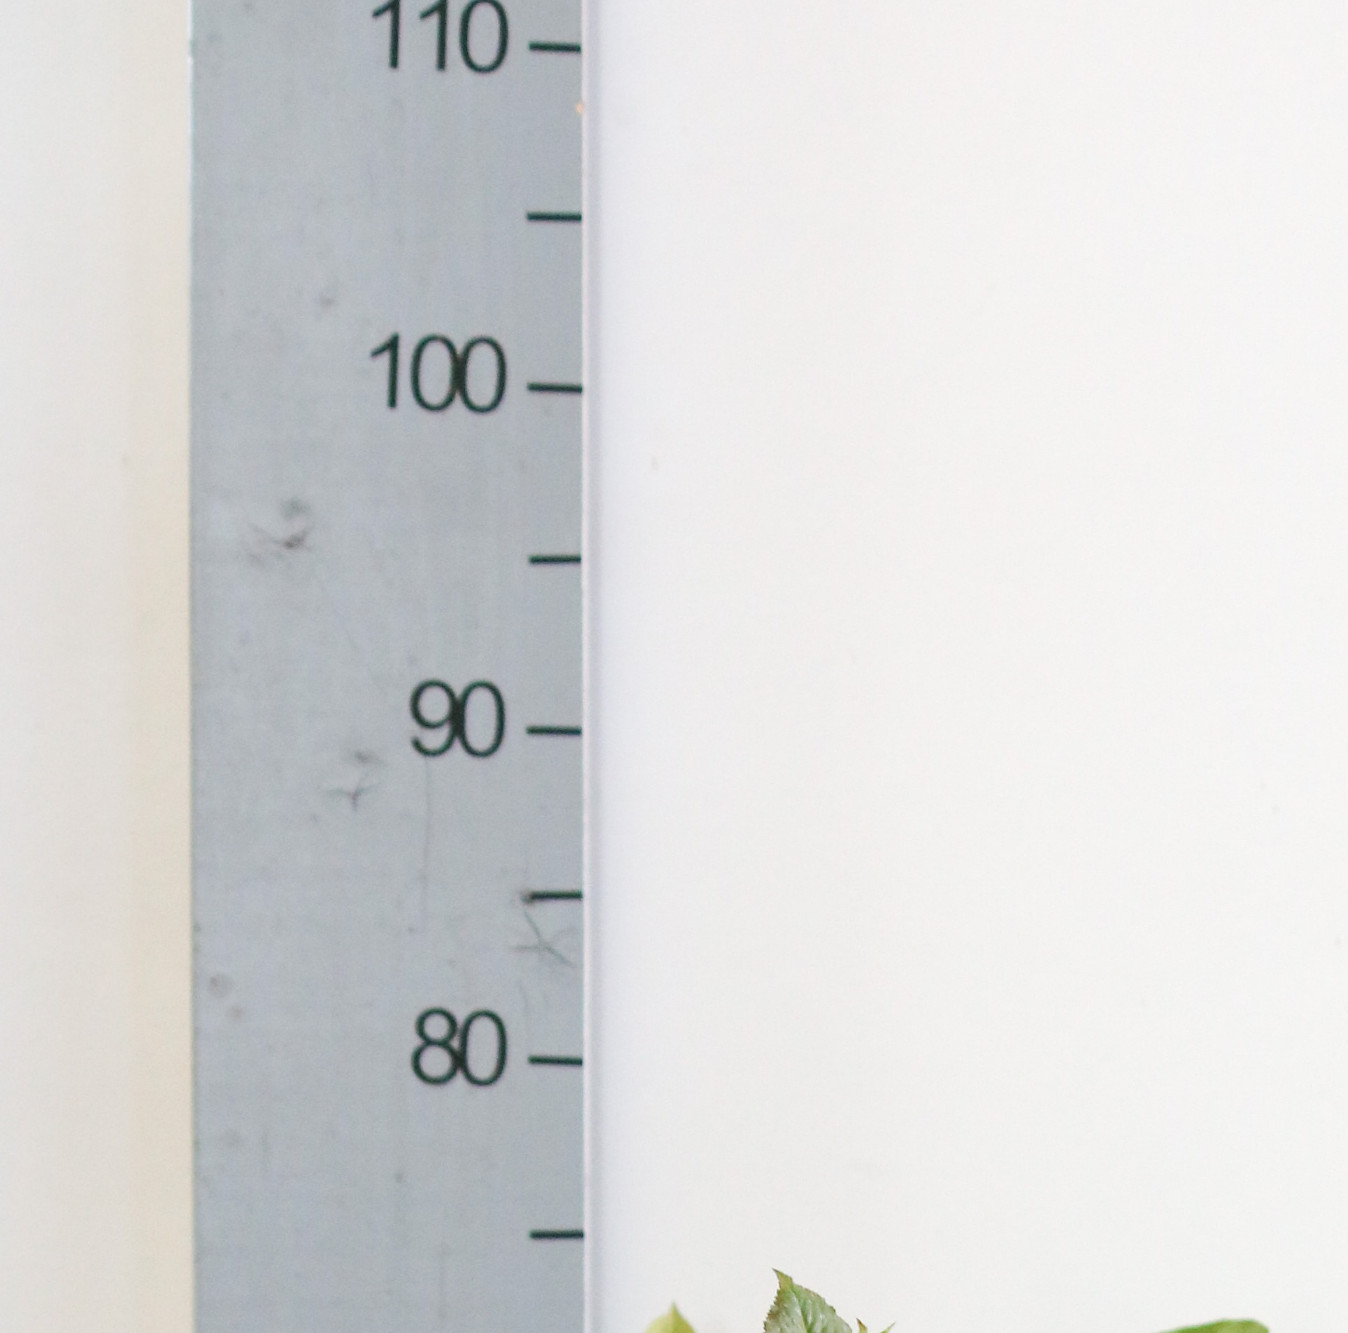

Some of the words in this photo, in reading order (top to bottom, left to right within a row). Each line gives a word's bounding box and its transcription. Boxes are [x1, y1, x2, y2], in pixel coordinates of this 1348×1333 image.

[372, 0, 509, 73] 110
[370, 333, 508, 413] 100
[409, 679, 507, 758] 90
[411, 1007, 508, 1086] 80
